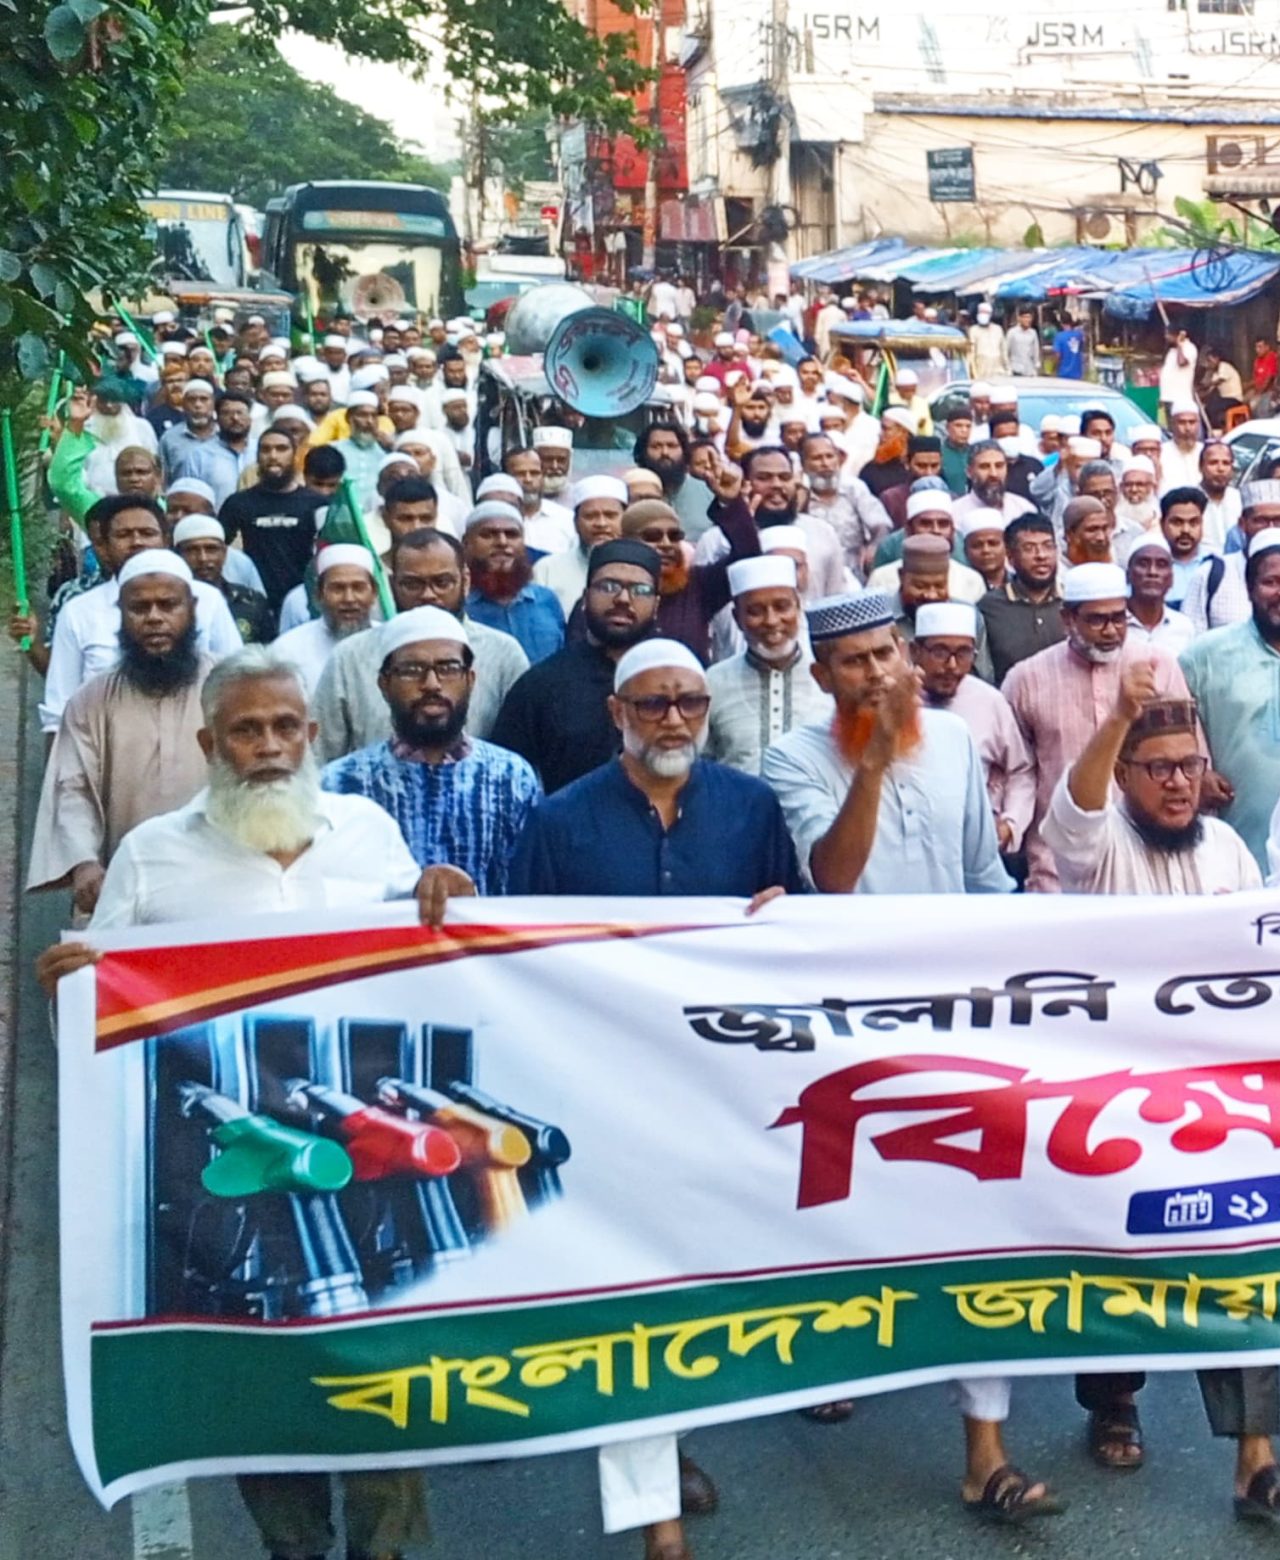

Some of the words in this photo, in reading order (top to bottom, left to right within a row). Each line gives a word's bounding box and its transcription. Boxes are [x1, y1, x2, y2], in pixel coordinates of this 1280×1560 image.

[1027, 22, 1104, 47] JSRM
[684, 971, 1116, 1052] জ্বালানি
[1227, 1193, 1268, 1221] ২১
[311, 1286, 918, 1429] বাংলাদেশ
